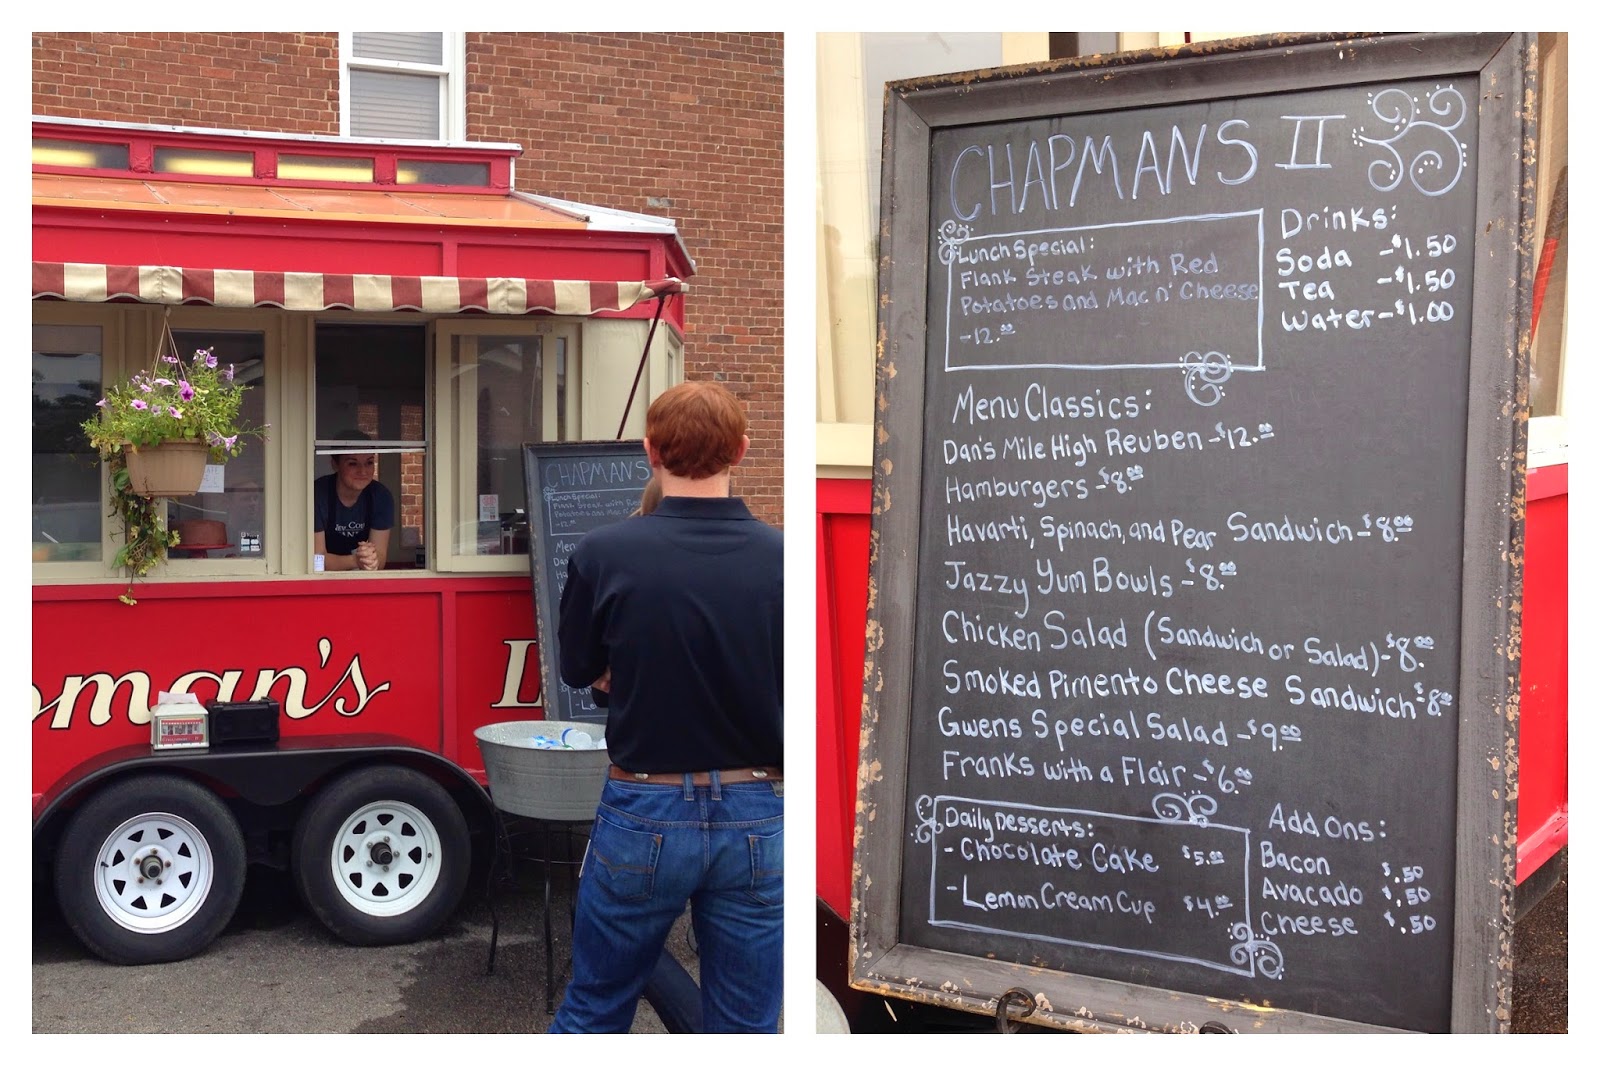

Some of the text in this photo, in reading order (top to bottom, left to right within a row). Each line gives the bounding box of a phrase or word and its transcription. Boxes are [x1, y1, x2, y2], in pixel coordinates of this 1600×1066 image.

[950, 114, 1346, 221] CHAPMANS II
[1281, 205, 1397, 239] Drinks:
[957, 236, 1095, 266] Lunch Special:
[1276, 246, 1352, 276] Soda
[960, 251, 1219, 289] Flank Steak with Red
[960, 292, 1059, 316] Potatoes
[1062, 291, 1098, 311] and
[1107, 287, 1148, 308] Mac
[1180, 281, 1258, 300] Cheese
[1278, 280, 1334, 300] Tea
[952, 382, 1152, 424] Menu Classics:
[943, 435, 996, 465] Dan's
[1002, 437, 1046, 460] Mile
[1051, 432, 1097, 467] High
[1105, 428, 1203, 456] Reuben
[546, 461, 650, 488] CHAPMANS
[945, 475, 1088, 508] Hamburgers
[556, 540, 576, 553] Men
[947, 514, 1034, 549] Havarti,
[1170, 518, 1216, 550] Pear
[1226, 511, 1353, 544] Sandwich
[944, 561, 1029, 619] Jazzy
[1036, 558, 1087, 595] Yum
[1092, 556, 1172, 598] Bowls
[942, 609, 1041, 652] Chicken
[1043, 610, 1127, 649] Salad
[1144, 610, 1263, 661] (Sandwich
[1268, 641, 1294, 661] or
[32, 638, 390, 729] man's
[943, 659, 1041, 698] Smoked
[1048, 667, 1158, 700] Pimento
[1166, 667, 1268, 698] Cheese
[1285, 674, 1416, 720] Sandwich
[938, 706, 1023, 738] Gwens
[1031, 708, 1140, 752] Special
[1146, 712, 1228, 747] Salad
[942, 750, 1035, 780] Franks
[1043, 757, 1093, 782] with
[1100, 765, 1114, 784] a
[1121, 755, 1186, 787] Flair
[945, 807, 1095, 842] Daily Desserts:
[1269, 802, 1386, 842] Add Ons:
[1092, 842, 1158, 874] Cake
[1260, 841, 1331, 875] Bacon
[1040, 882, 1115, 912] Cream
[1117, 890, 1155, 923] Cup
[1262, 877, 1363, 906] Avacado
[1260, 911, 1358, 936] Cheese
